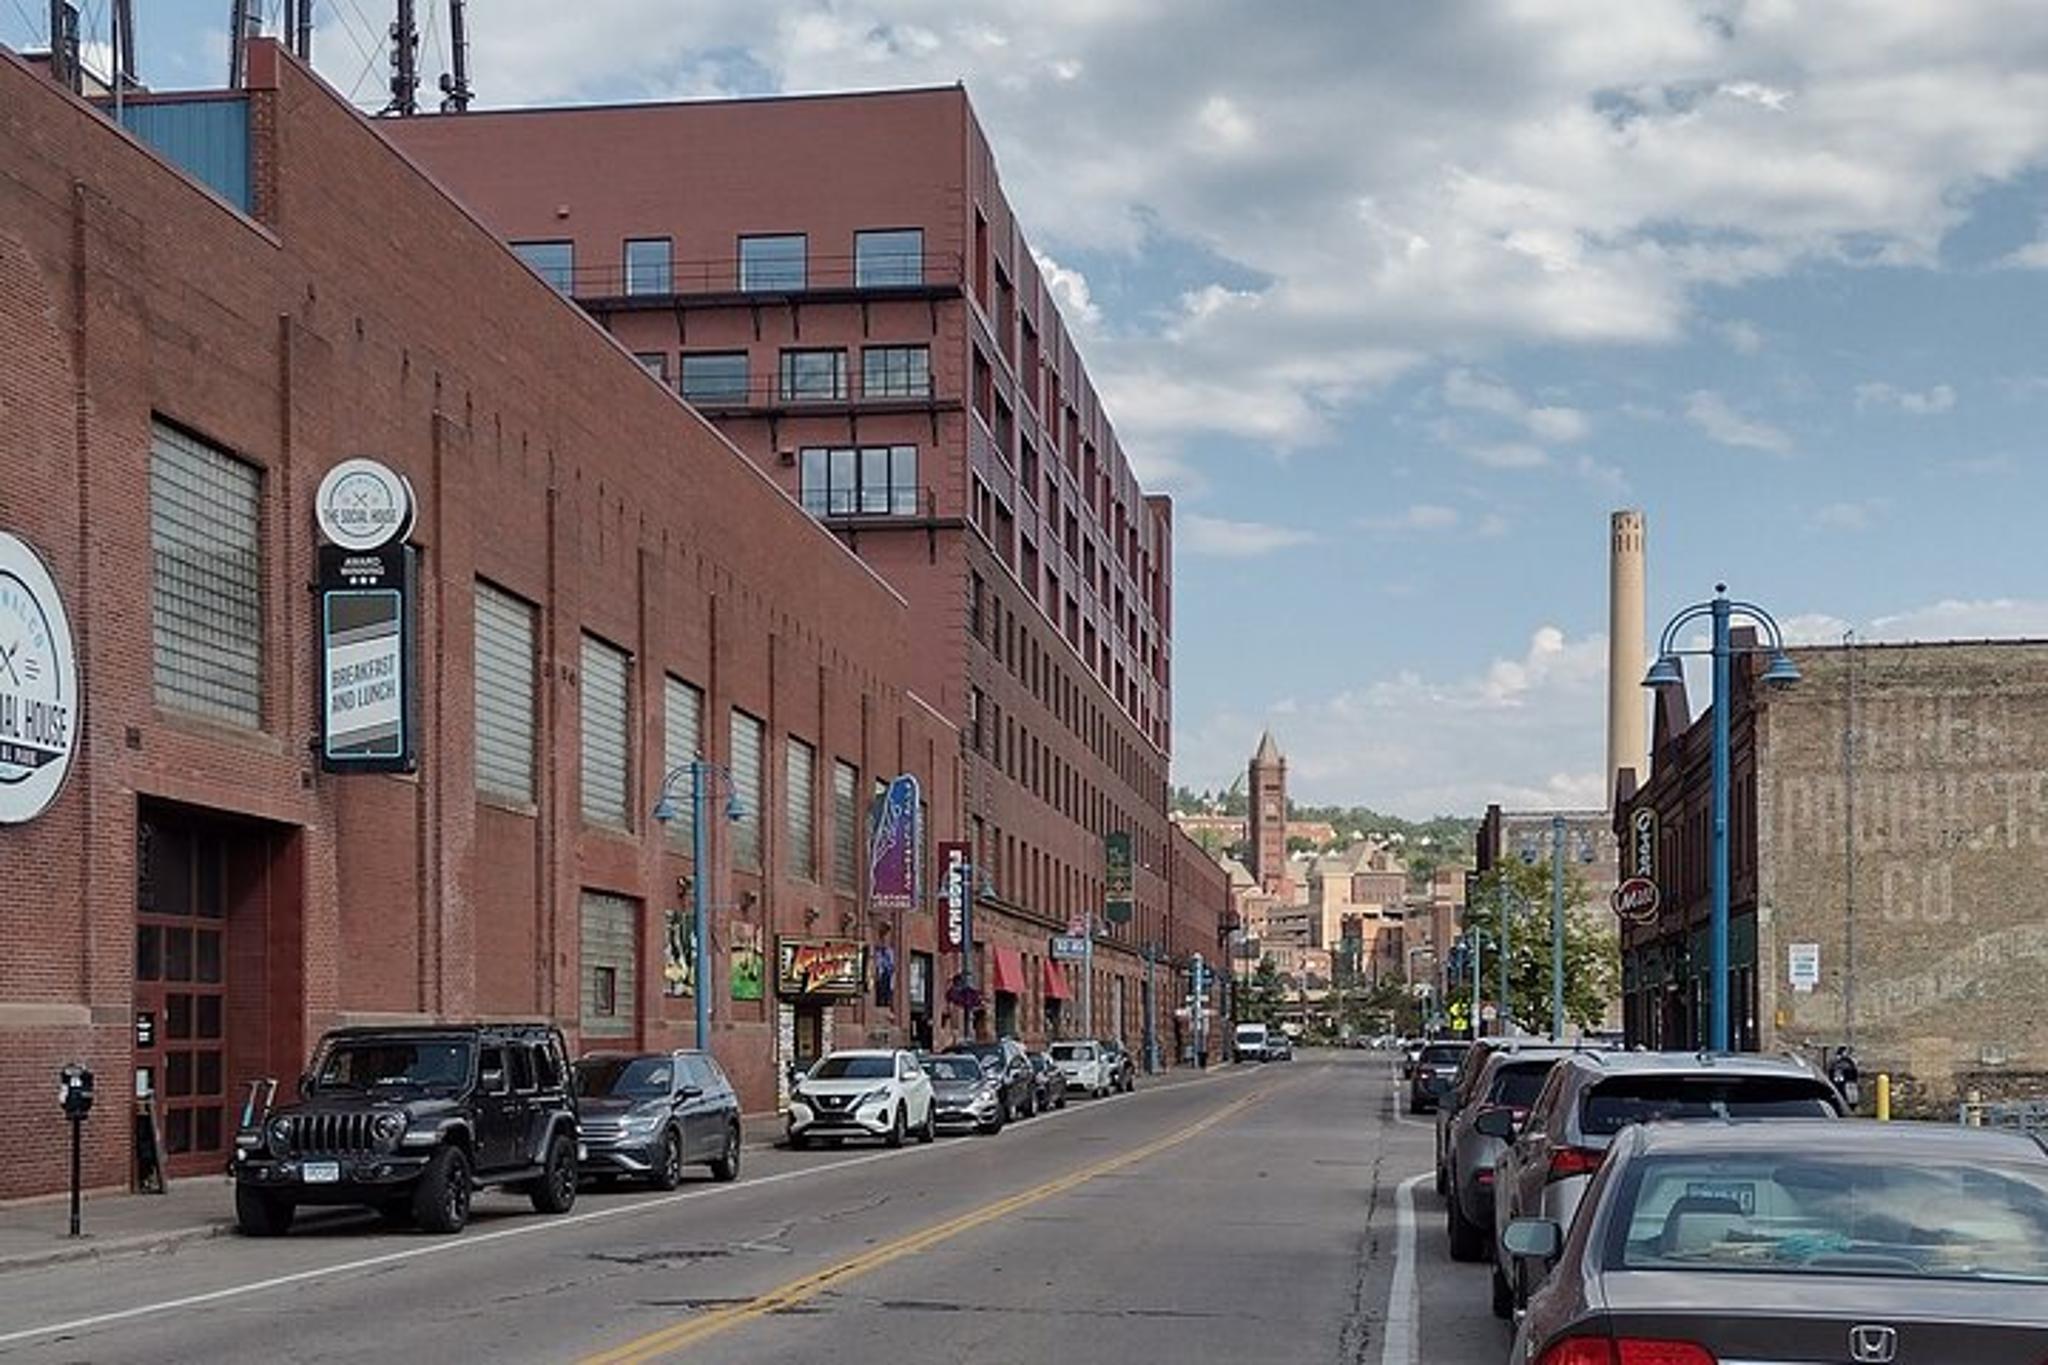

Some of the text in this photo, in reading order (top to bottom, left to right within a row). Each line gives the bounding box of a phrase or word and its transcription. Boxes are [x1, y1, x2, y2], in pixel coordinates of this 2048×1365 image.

[332, 653, 396, 690] BREAKFAST
[332, 679, 396, 712] AND LUNCH
[25, 699, 67, 748] HOUSE
